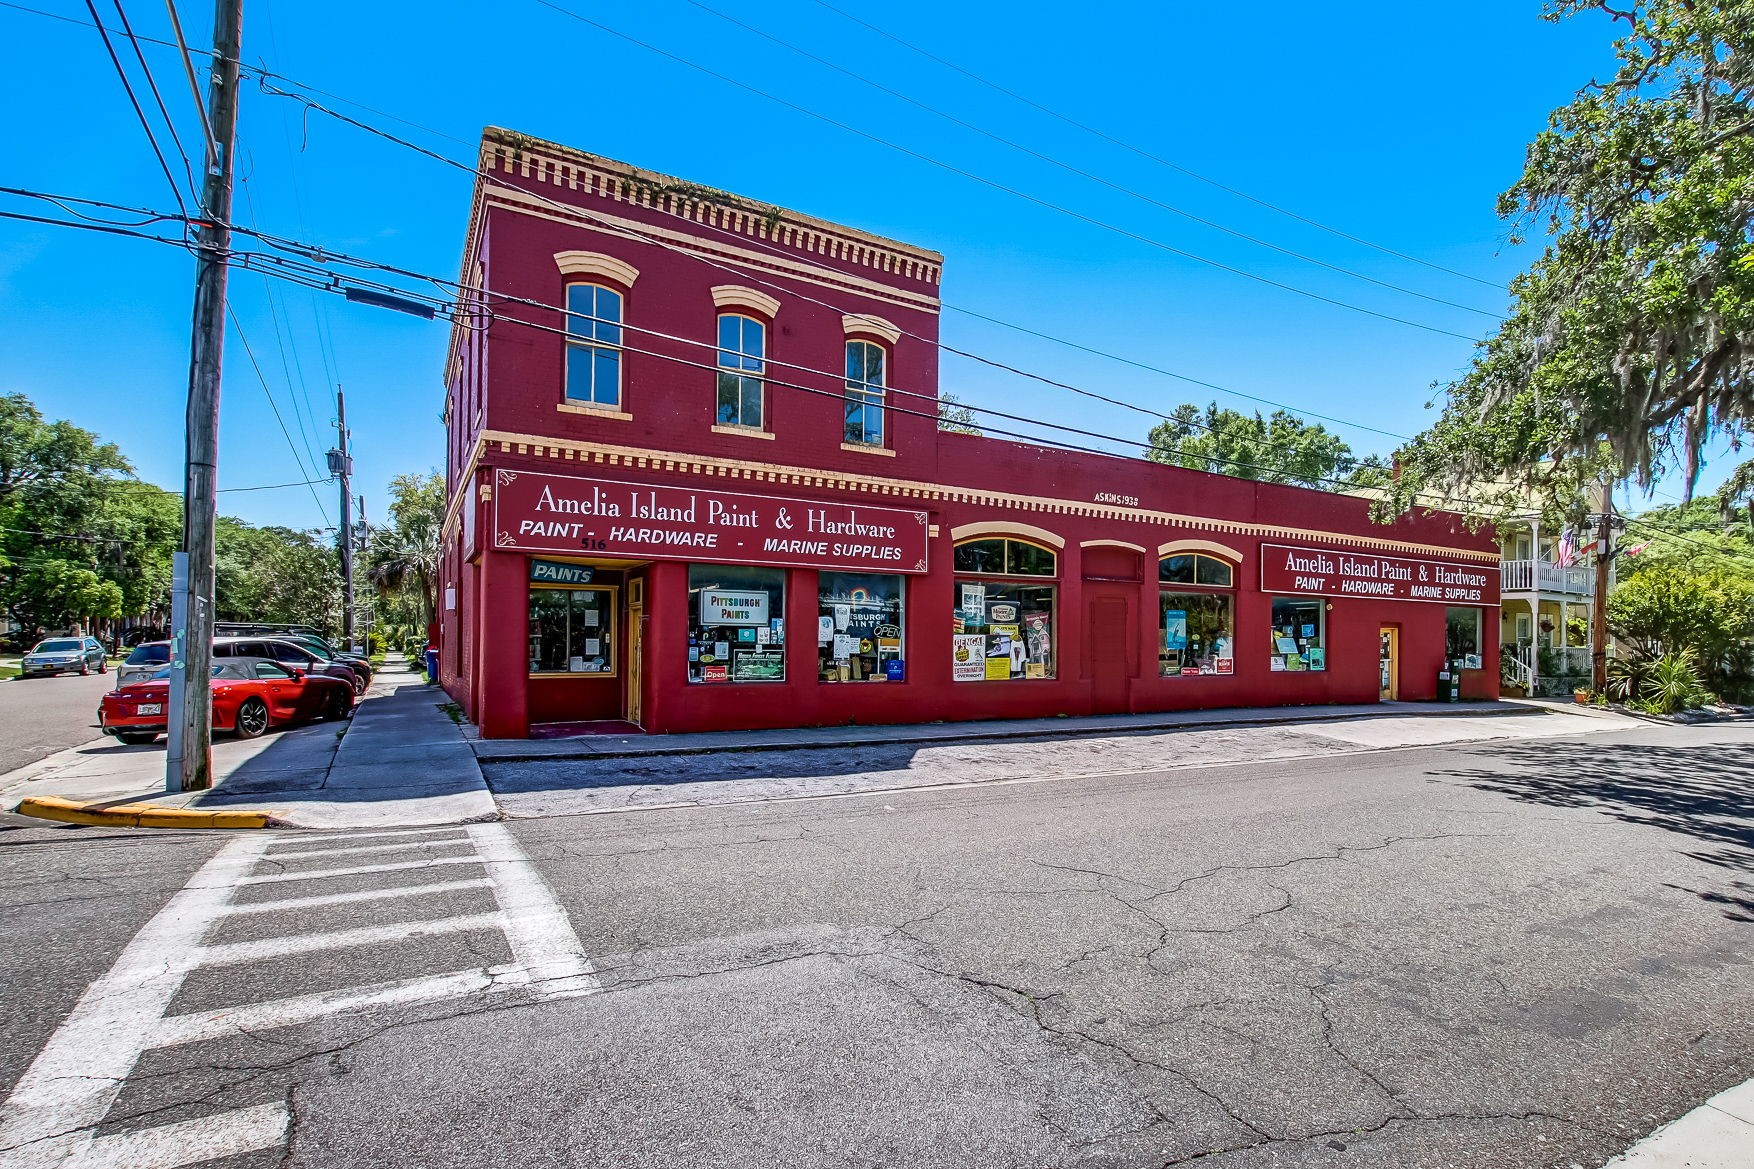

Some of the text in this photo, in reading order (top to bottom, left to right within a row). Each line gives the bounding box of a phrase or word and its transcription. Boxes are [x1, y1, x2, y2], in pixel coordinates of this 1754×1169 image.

[1094, 492, 1121, 504] ASKINS
[535, 484, 895, 539] Amelia Island Paint & Hardware
[519, 520, 583, 538] PAINT
[609, 526, 718, 548] HARDWARE
[763, 538, 828, 556] MARINE
[832, 543, 902, 560] SUPPLIES
[581, 538, 606, 550] 516
[534, 564, 592, 583] PAINTS
[1285, 551, 1487, 587] Amelia Island Paint & Hardware
[1294, 576, 1326, 591] PAINT
[1341, 579, 1395, 596] HARDWARE
[1410, 585, 1442, 598] MARINE
[1444, 587, 1481, 601] SUPPLIES
[711, 595, 760, 607] PITTSBURGH
[721, 608, 750, 620] PAINTS
[848, 620, 881, 628] AINTS
[874, 626, 901, 638] OPEN
